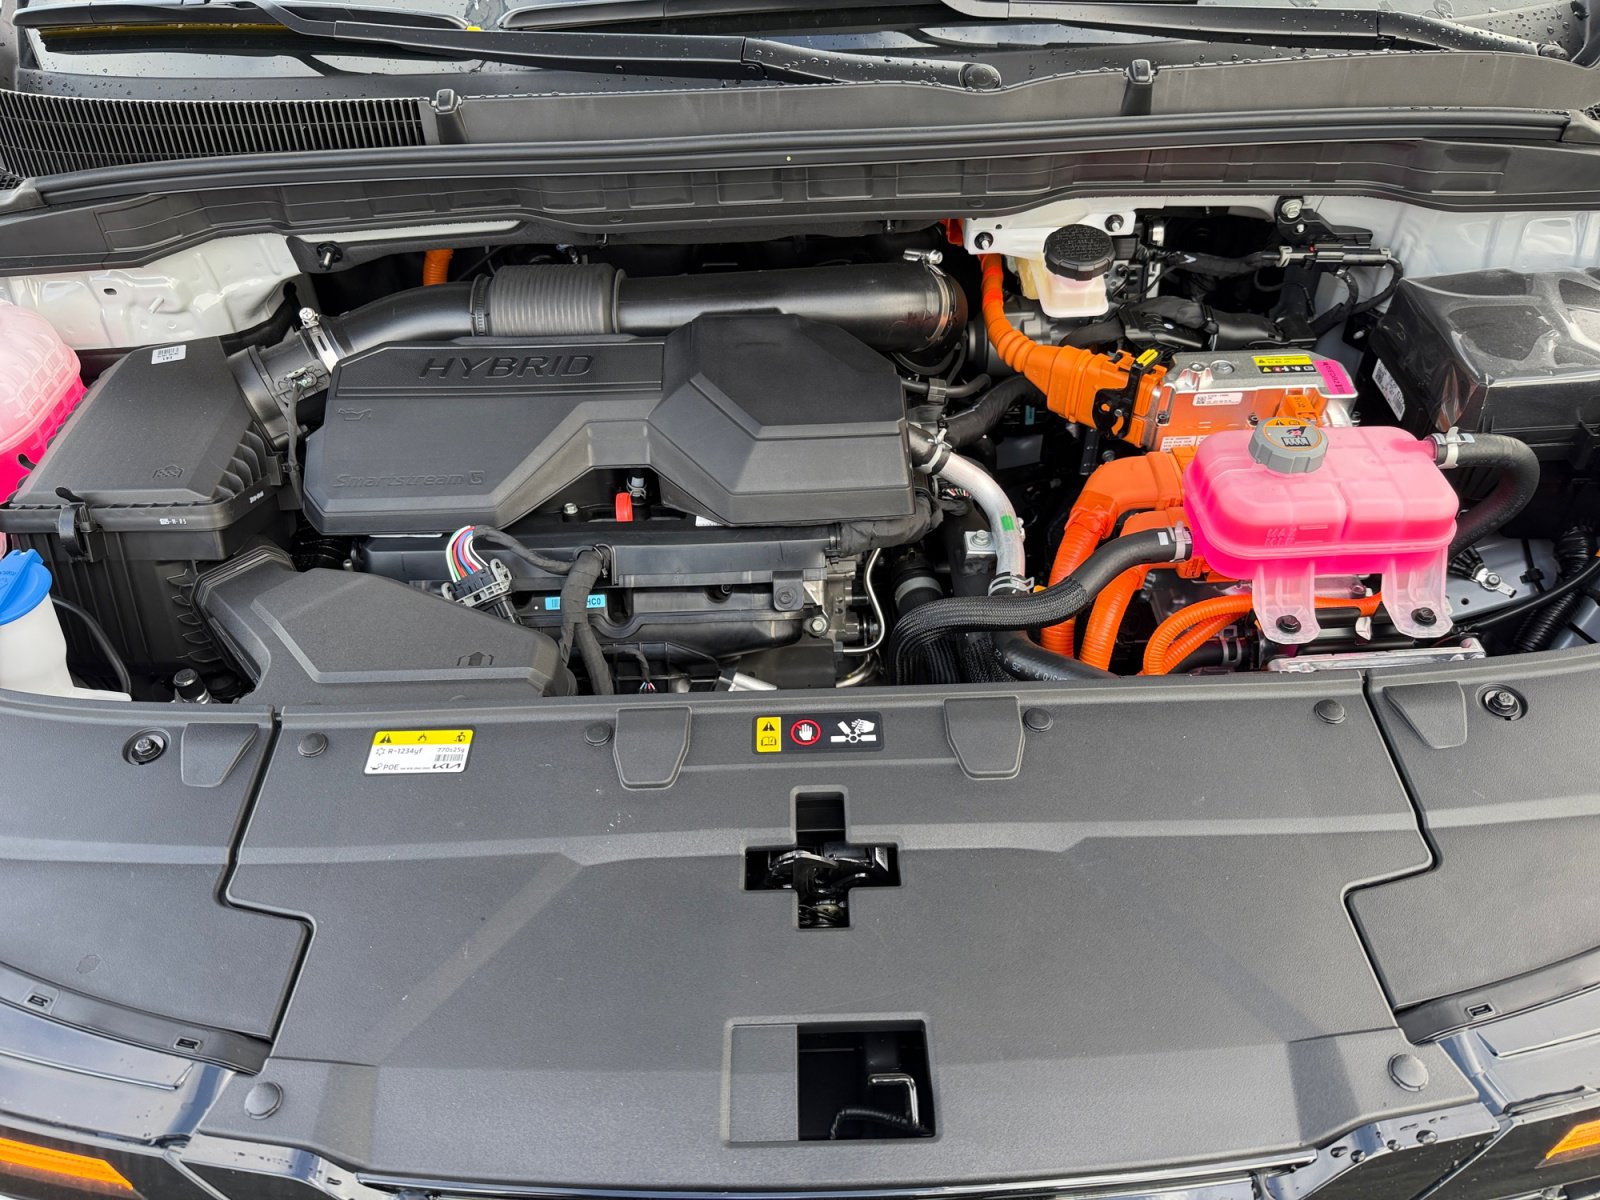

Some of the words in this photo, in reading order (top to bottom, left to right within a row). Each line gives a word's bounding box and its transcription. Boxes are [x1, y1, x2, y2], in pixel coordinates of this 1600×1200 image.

[419, 355, 594, 379] HYBRID
[333, 473, 465, 488] Smartstream
[387, 747, 423, 755] R-1234yf
